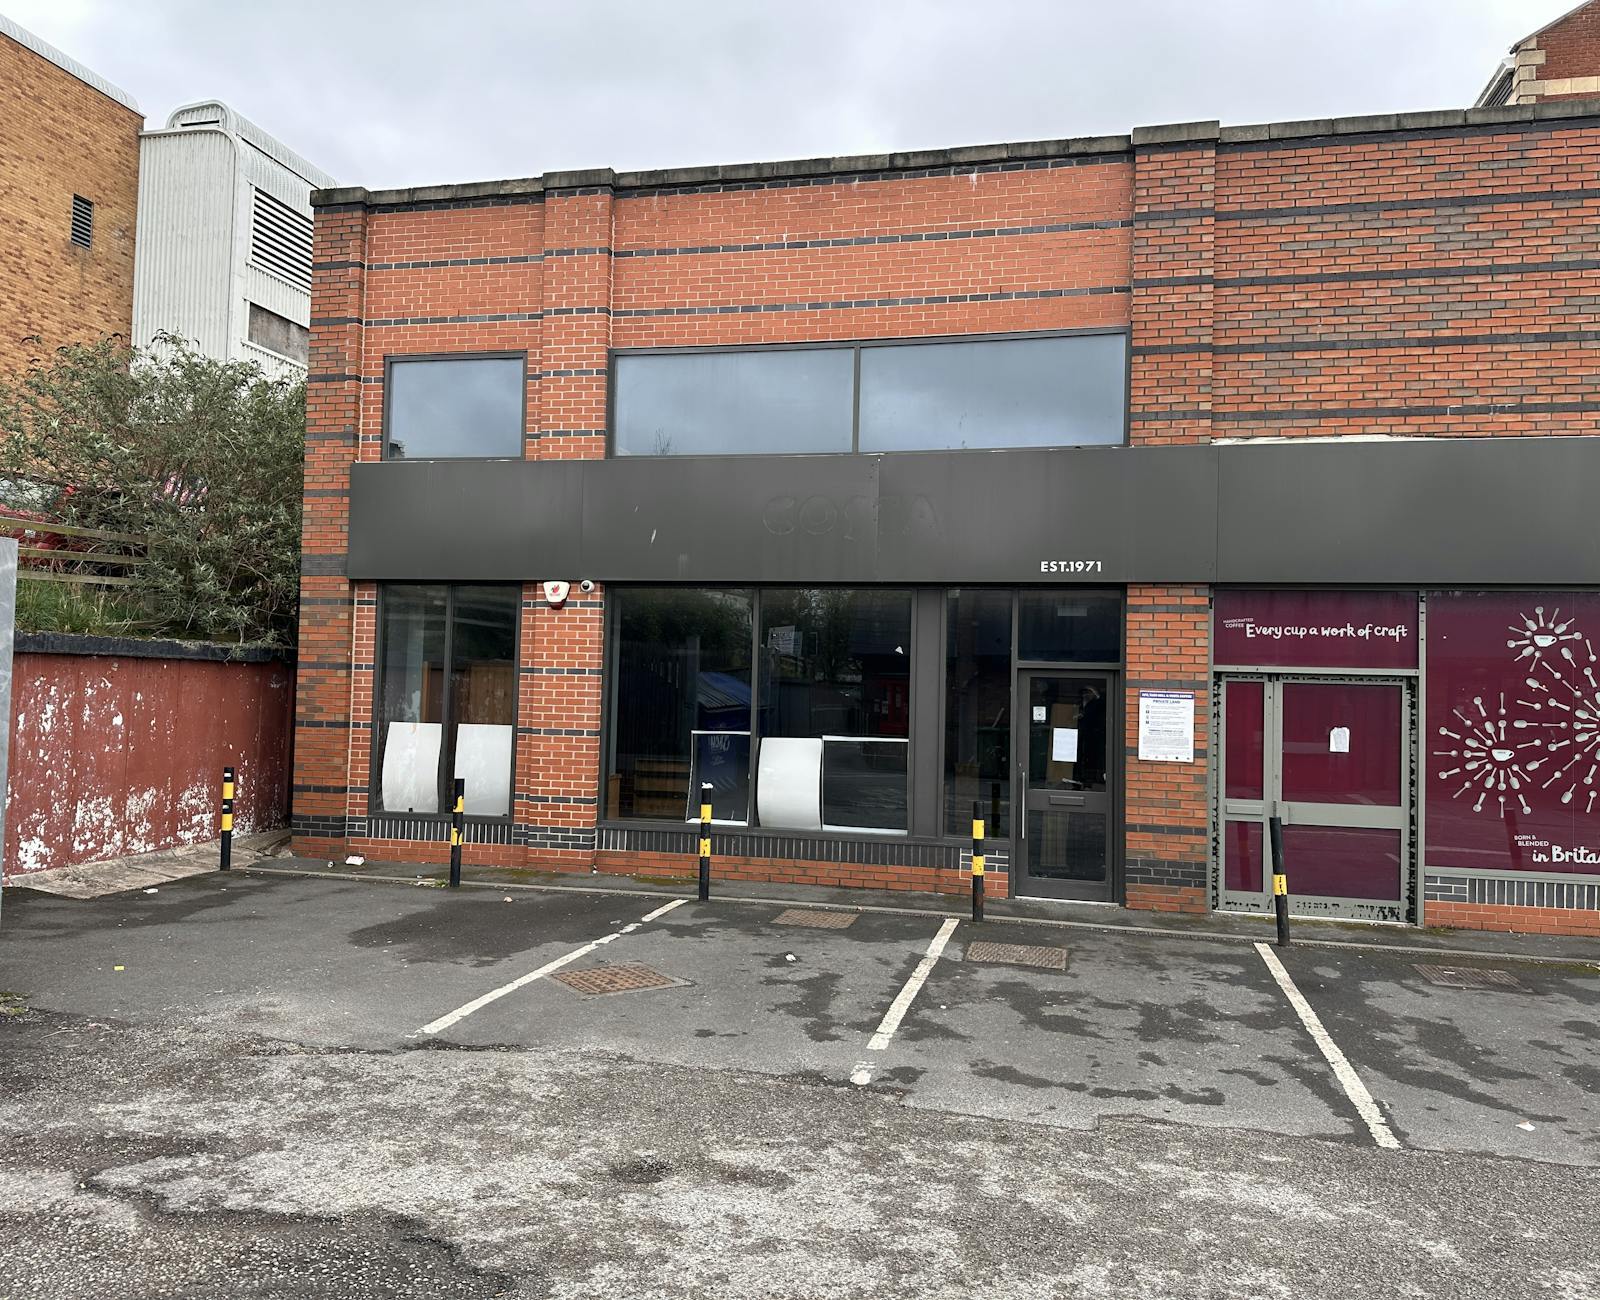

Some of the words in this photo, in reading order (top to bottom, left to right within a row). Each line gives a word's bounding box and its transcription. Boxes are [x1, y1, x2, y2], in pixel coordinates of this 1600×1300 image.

[761, 493, 944, 541] COA
[1040, 560, 1102, 573] EST.1971
[1245, 623, 1283, 640] Every
[1283, 626, 1308, 639] cup
[1308, 626, 1319, 635] a
[1320, 622, 1357, 638] work
[1357, 623, 1373, 640] of
[1373, 624, 1408, 643] craft
[1532, 849, 1550, 863] in
[1551, 844, 1600, 864] Brita
